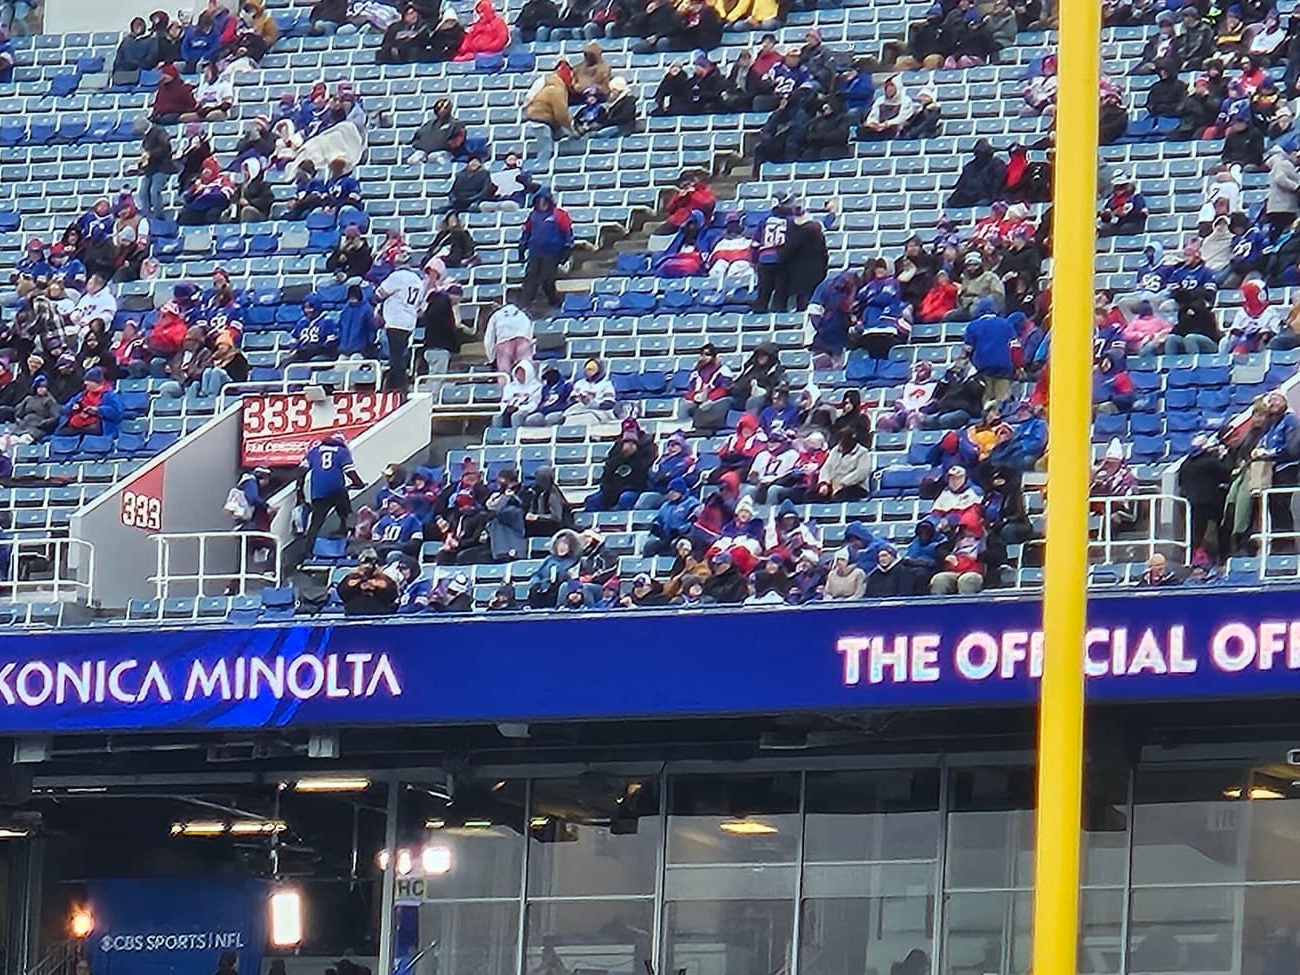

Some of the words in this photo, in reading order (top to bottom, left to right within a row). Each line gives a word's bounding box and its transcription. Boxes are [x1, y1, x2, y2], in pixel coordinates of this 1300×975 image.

[406, 286, 420, 305] 17
[243, 393, 313, 432] 333
[321, 453, 333, 469] 8
[121, 490, 162, 530] 333
[836, 634, 941, 685] THE
[955, 625, 1197, 680] OFFCIAL
[184, 652, 401, 702] MINOLTA
[398, 879, 425, 897] HC
[113, 935, 143, 951] CBS
[146, 933, 206, 951] SPORTS
[215, 932, 245, 949] NFL
